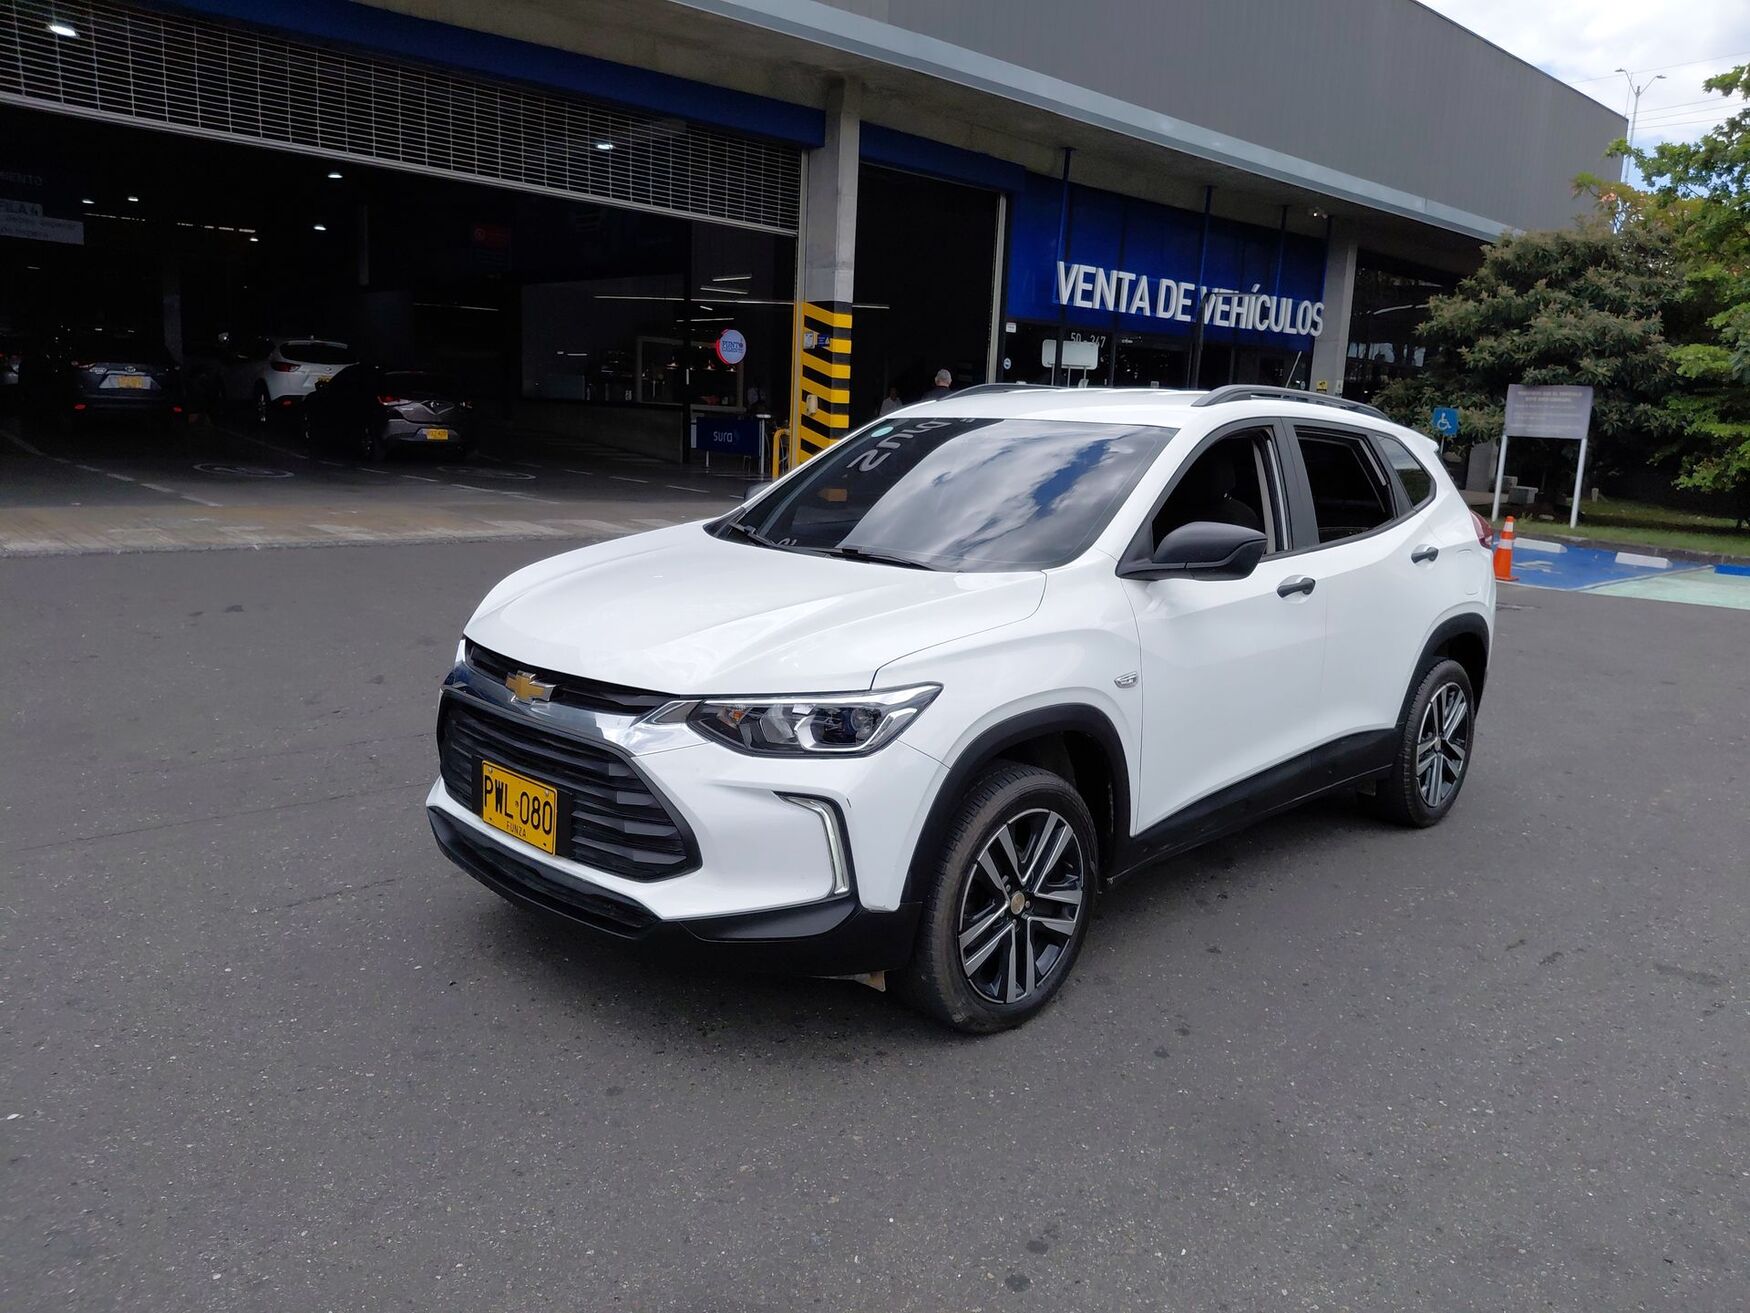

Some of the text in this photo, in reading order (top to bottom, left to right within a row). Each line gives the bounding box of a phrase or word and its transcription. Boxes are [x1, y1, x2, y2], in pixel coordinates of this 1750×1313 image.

[1057, 261, 1325, 337] VENTA DE VEHÍCULOS
[713, 431, 733, 443] sura
[485, 776, 552, 835] PWL 080
[507, 822, 527, 837] FUNZA
